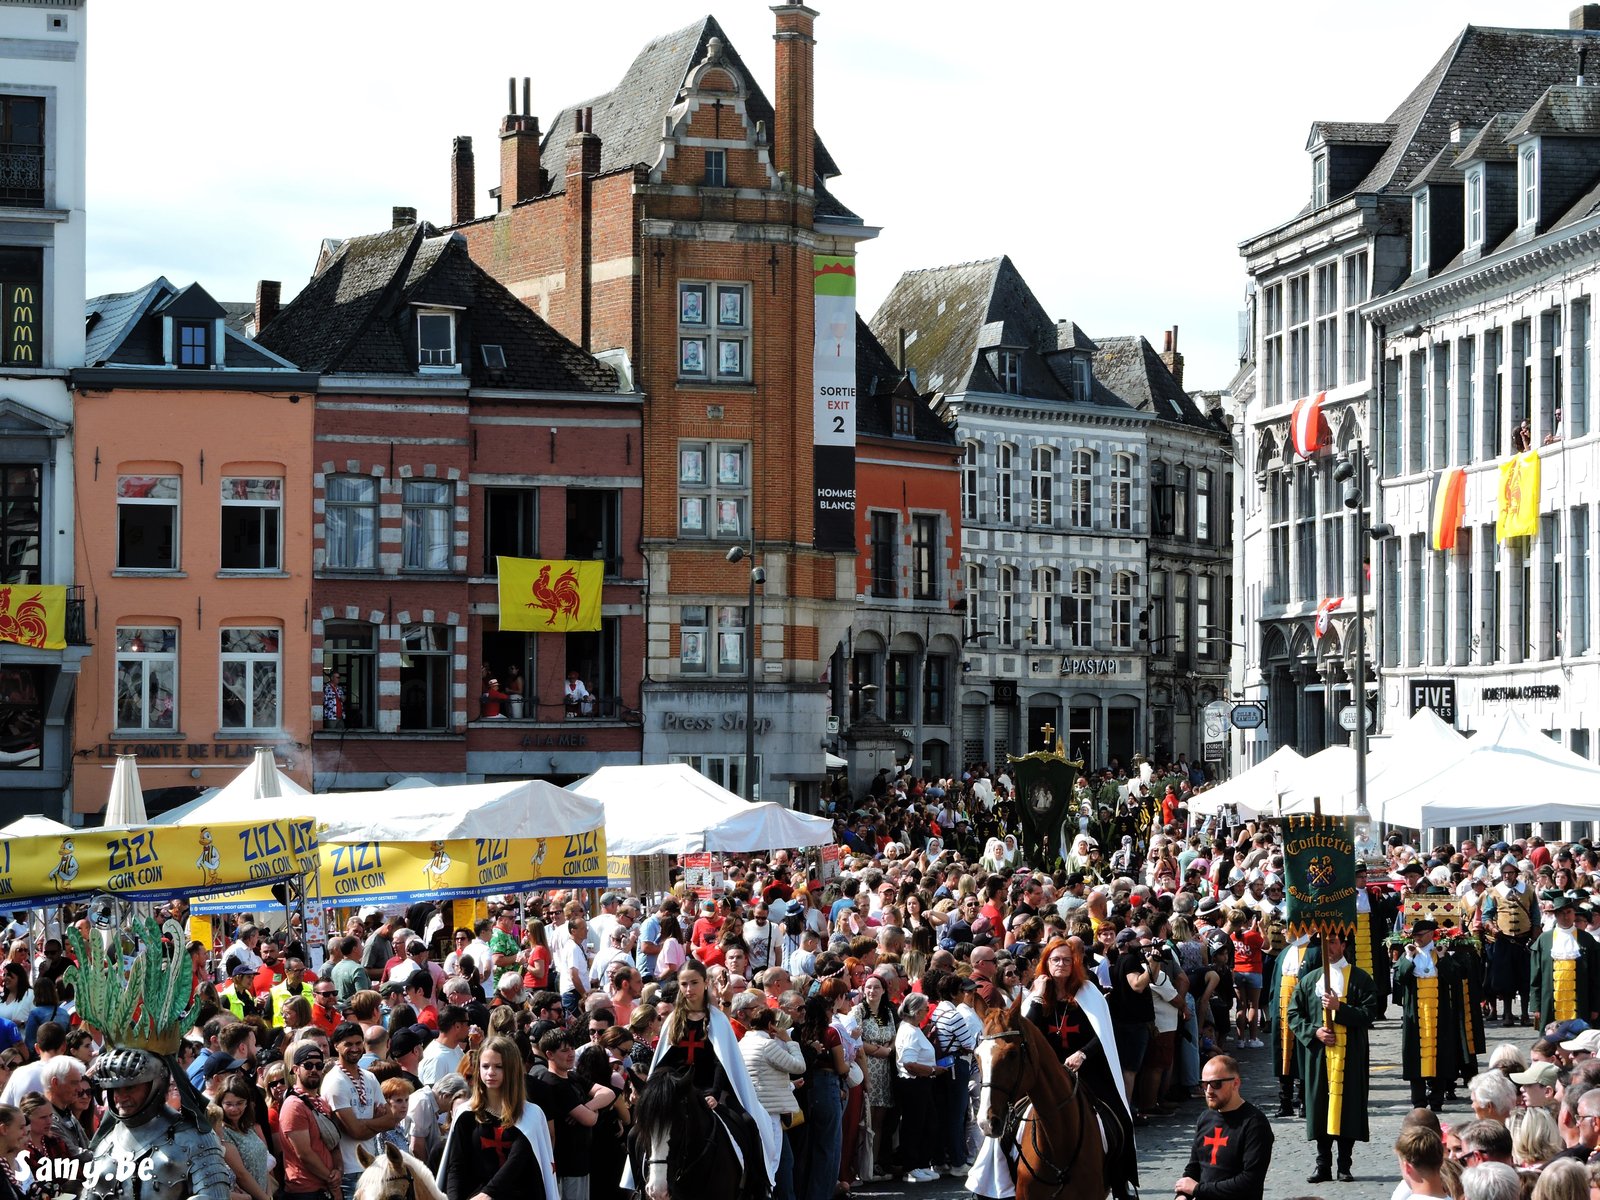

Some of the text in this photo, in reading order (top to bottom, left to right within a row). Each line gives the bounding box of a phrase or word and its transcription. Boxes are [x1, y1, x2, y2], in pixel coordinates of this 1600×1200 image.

[820, 386, 856, 397] SORTIE
[827, 400, 850, 411] EXIT
[832, 415, 845, 433] 2
[817, 488, 856, 499] HOMMES
[820, 500, 856, 511] BLANCS
[1415, 687, 1451, 707] FIVE
[664, 712, 715, 731] Press
[98, 744, 116, 758] LE
[124, 744, 181, 758] COMTE
[188, 744, 208, 758] DE
[107, 831, 158, 870] ZIZI
[239, 822, 287, 862] ZIZI
[475, 839, 509, 866] ZIZI
[564, 830, 598, 858] ZIZI
[1286, 832, 1352, 855] Confrérie
[331, 842, 381, 877] ZIZI
[563, 856, 600, 876] COIN COIN
[108, 866, 162, 891] COIN COIN
[335, 872, 386, 894] COIN COIN
[478, 862, 508, 885] COIN COIN
